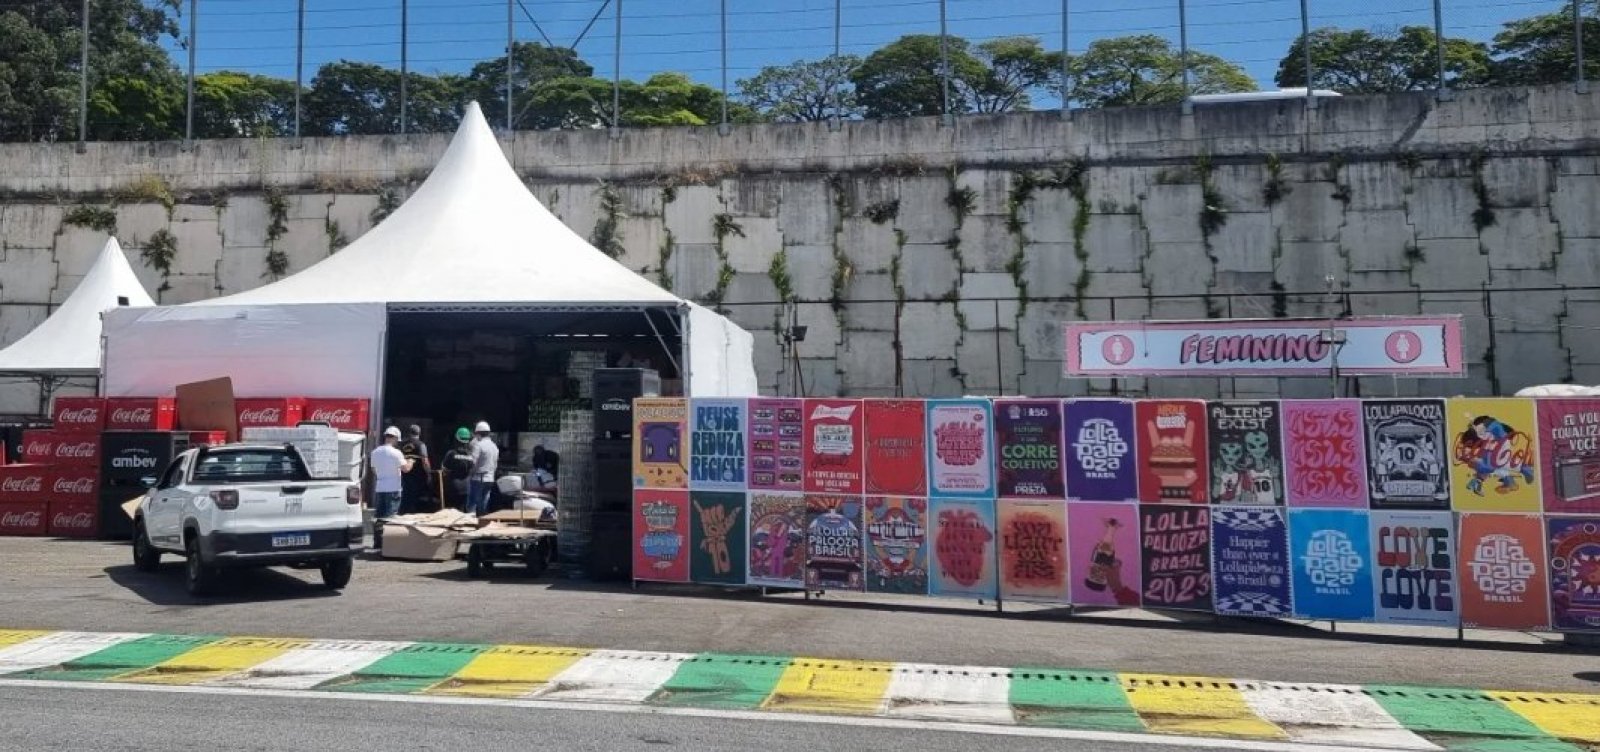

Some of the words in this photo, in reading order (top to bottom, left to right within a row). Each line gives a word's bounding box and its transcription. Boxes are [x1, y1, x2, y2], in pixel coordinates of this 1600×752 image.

[1179, 331, 1331, 364] FEMININO
[697, 406, 739, 431] REUSE
[1213, 406, 1273, 418] ALIENS
[1365, 404, 1443, 420] LOLLAPALOOZA
[1218, 418, 1269, 430] EXIST
[692, 432, 744, 456] REDUZA
[1002, 444, 1058, 459] CORRE
[1398, 446, 1416, 461] 10
[112, 455, 157, 468] ambev
[691, 456, 744, 482] RECICLE
[1002, 460, 1058, 470] COLETIVO
[1144, 509, 1208, 532] LOLLA
[818, 526, 849, 537] LOLLA
[809, 536, 859, 548] PALOOZA
[1144, 530, 1208, 553] PALOOZA
[1229, 536, 1270, 549] Happier
[1378, 527, 1450, 569] LOVE
[815, 546, 851, 556] BRASIL
[1222, 548, 1246, 560] than
[1151, 553, 1204, 572] BRASIL
[1144, 573, 1211, 603] 2023
[1315, 587, 1351, 595] BRASIL
[1380, 568, 1453, 611] LOVE
